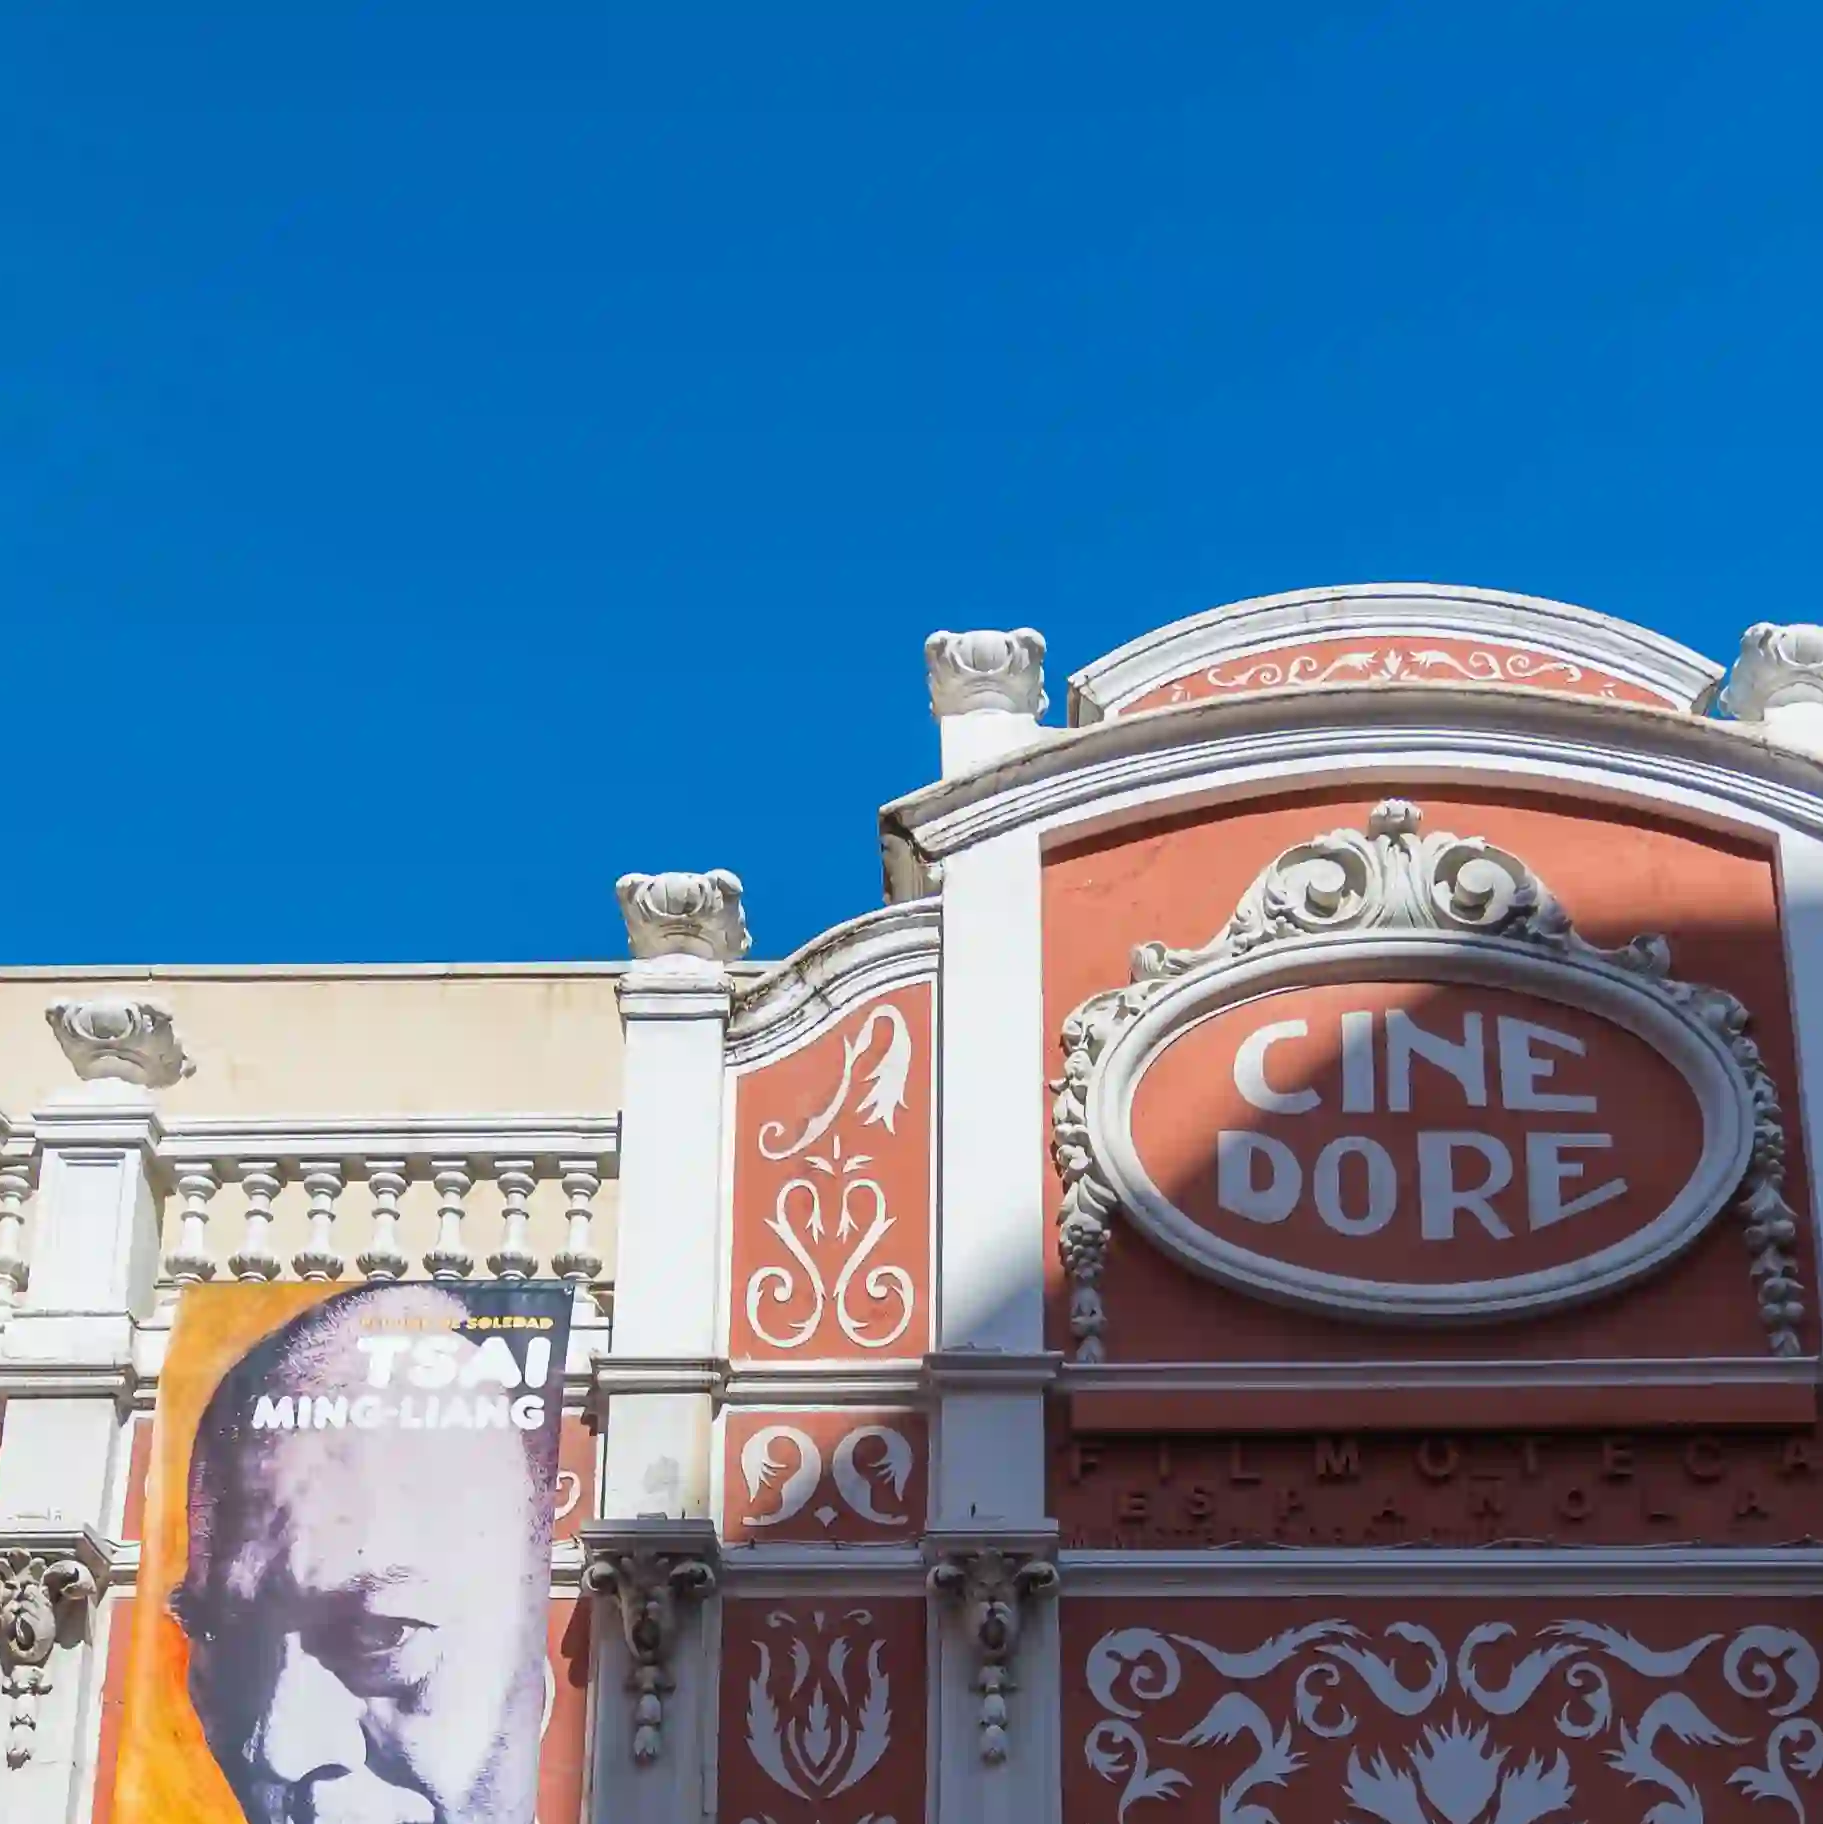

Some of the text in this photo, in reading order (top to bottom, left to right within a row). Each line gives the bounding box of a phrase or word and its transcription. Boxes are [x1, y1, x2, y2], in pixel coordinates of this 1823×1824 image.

[1232, 1008, 1598, 1115] CINE
[1216, 1129, 1628, 1241] DORE
[466, 1315, 555, 1331] SOLEDAD
[357, 1336, 552, 1390] TSAI
[252, 1394, 546, 1431] MING-LIANG
[1069, 1437, 1820, 1486] FILMOTECA
[1120, 1477, 1772, 1522] ESPAÑOLA
